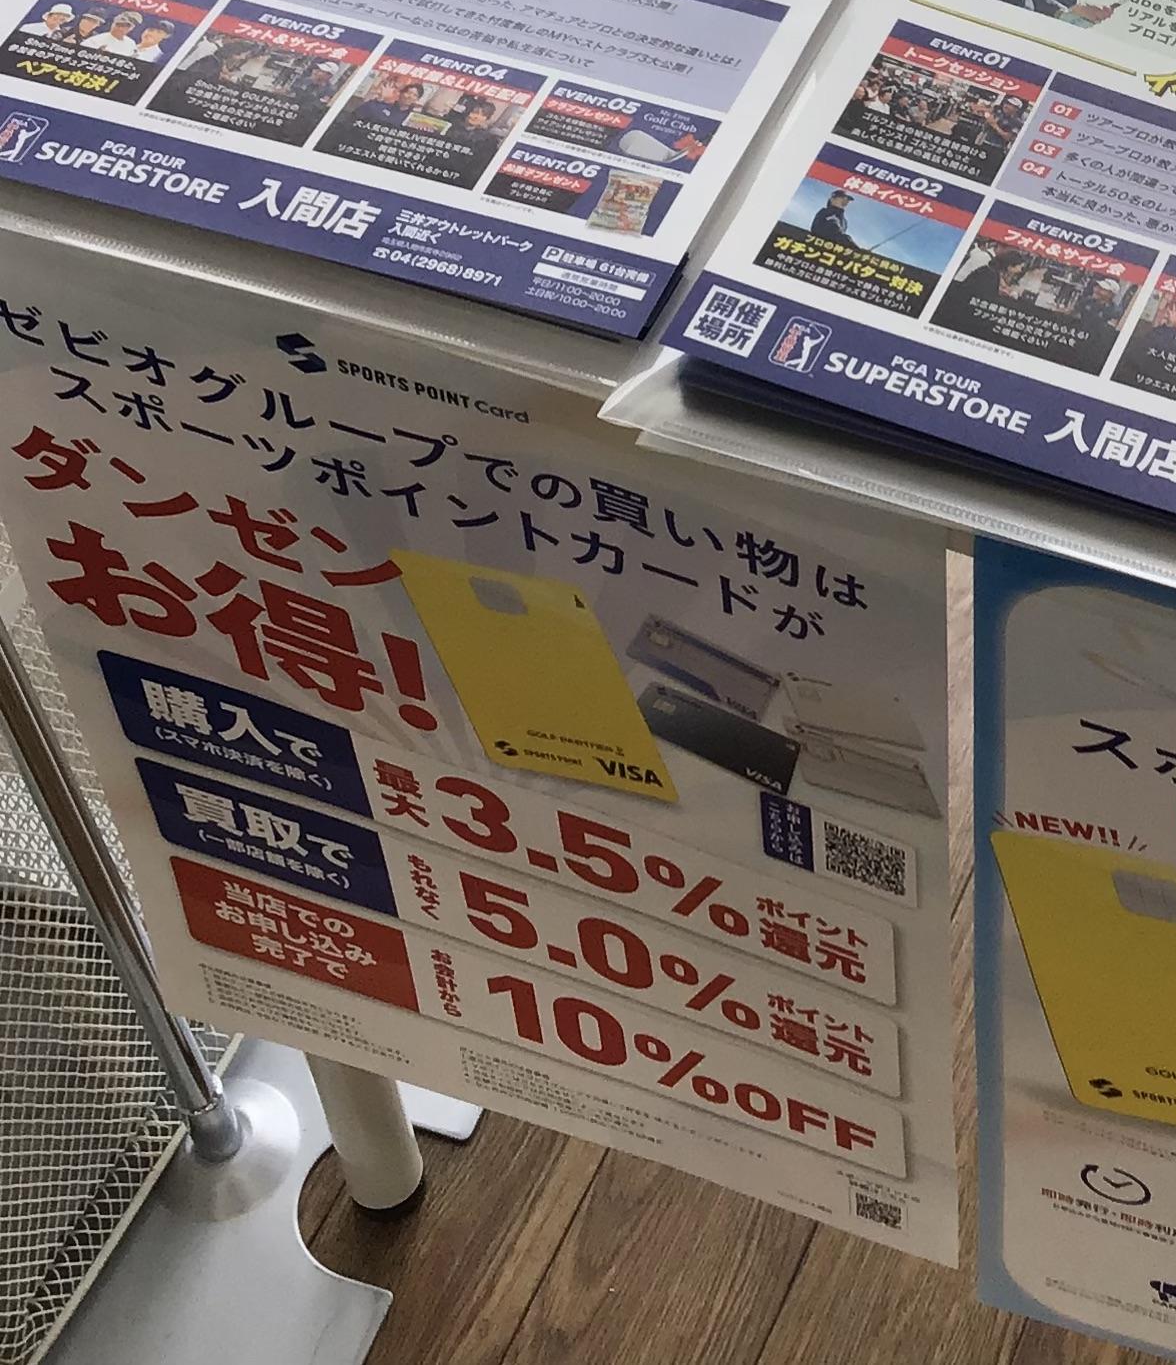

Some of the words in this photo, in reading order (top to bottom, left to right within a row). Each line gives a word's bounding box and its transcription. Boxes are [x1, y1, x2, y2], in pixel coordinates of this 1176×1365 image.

[258, 13, 346, 40] EVENT.03
[929, 37, 1011, 69] EVENT.01
[16, 60, 120, 94] ペアで対決!
[903, 47, 1020, 92] トークセッション
[101, 140, 136, 157] PGA
[140, 151, 186, 170] TOUR
[854, 162, 944, 197] EVENT.02
[35, 142, 230, 204] SUPERSTORE
[238, 178, 382, 239] 入間店
[843, 175, 934, 216] 体験イベント
[1026, 219, 1118, 253] EVENT.03
[693, 314, 757, 352] 場所
[705, 291, 769, 328] 開催
[338, 358, 411, 393] SPORTS
[414, 379, 470, 410] POINT
[474, 396, 530, 424] Card
[824, 352, 1032, 434] SUPERSTORE
[890, 355, 929, 379] PGA
[933, 367, 983, 393] TOUR
[14, 424, 405, 589] ダンゼン
[52, 365, 824, 642] スポーツポイントカードが
[46, 520, 440, 734] お得!
[139, 678, 324, 767] 購入で
[595, 756, 663, 789] VISA
[175, 782, 355, 870] 買取で
[1015, 811, 1120, 847] NEW!!
[435, 775, 750, 938] 3.5%
[223, 881, 356, 938] 当店での
[406, 853, 441, 920] もれなく
[214, 900, 378, 967] お申し込み
[757, 896, 869, 946] ポイント
[252, 932, 350, 980] 完了で
[459, 870, 761, 1031] 5.0%
[760, 916, 868, 985] 還元
[766, 992, 875, 1042] ポイント
[486, 975, 878, 1152] 10%OFF
[770, 1012, 874, 1078] 還元
